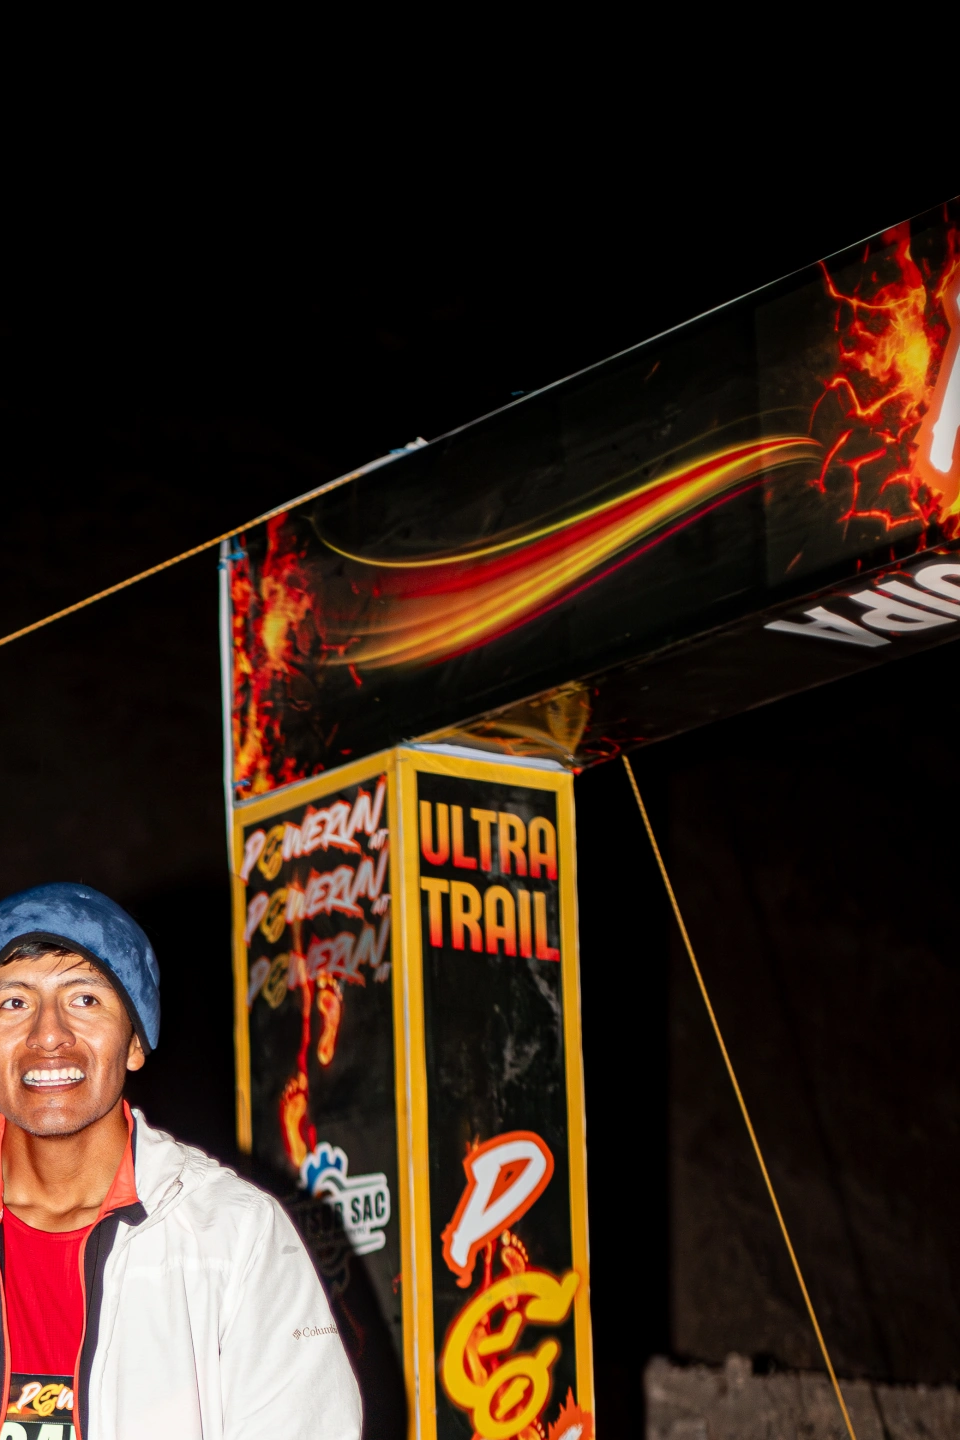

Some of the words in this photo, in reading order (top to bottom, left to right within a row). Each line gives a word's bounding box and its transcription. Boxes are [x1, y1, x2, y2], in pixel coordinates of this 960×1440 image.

[240, 773, 387, 885] POWERUN
[420, 800, 559, 882] ULTRA
[421, 875, 561, 962] TRAIL
[350, 1189, 387, 1225] SAC
